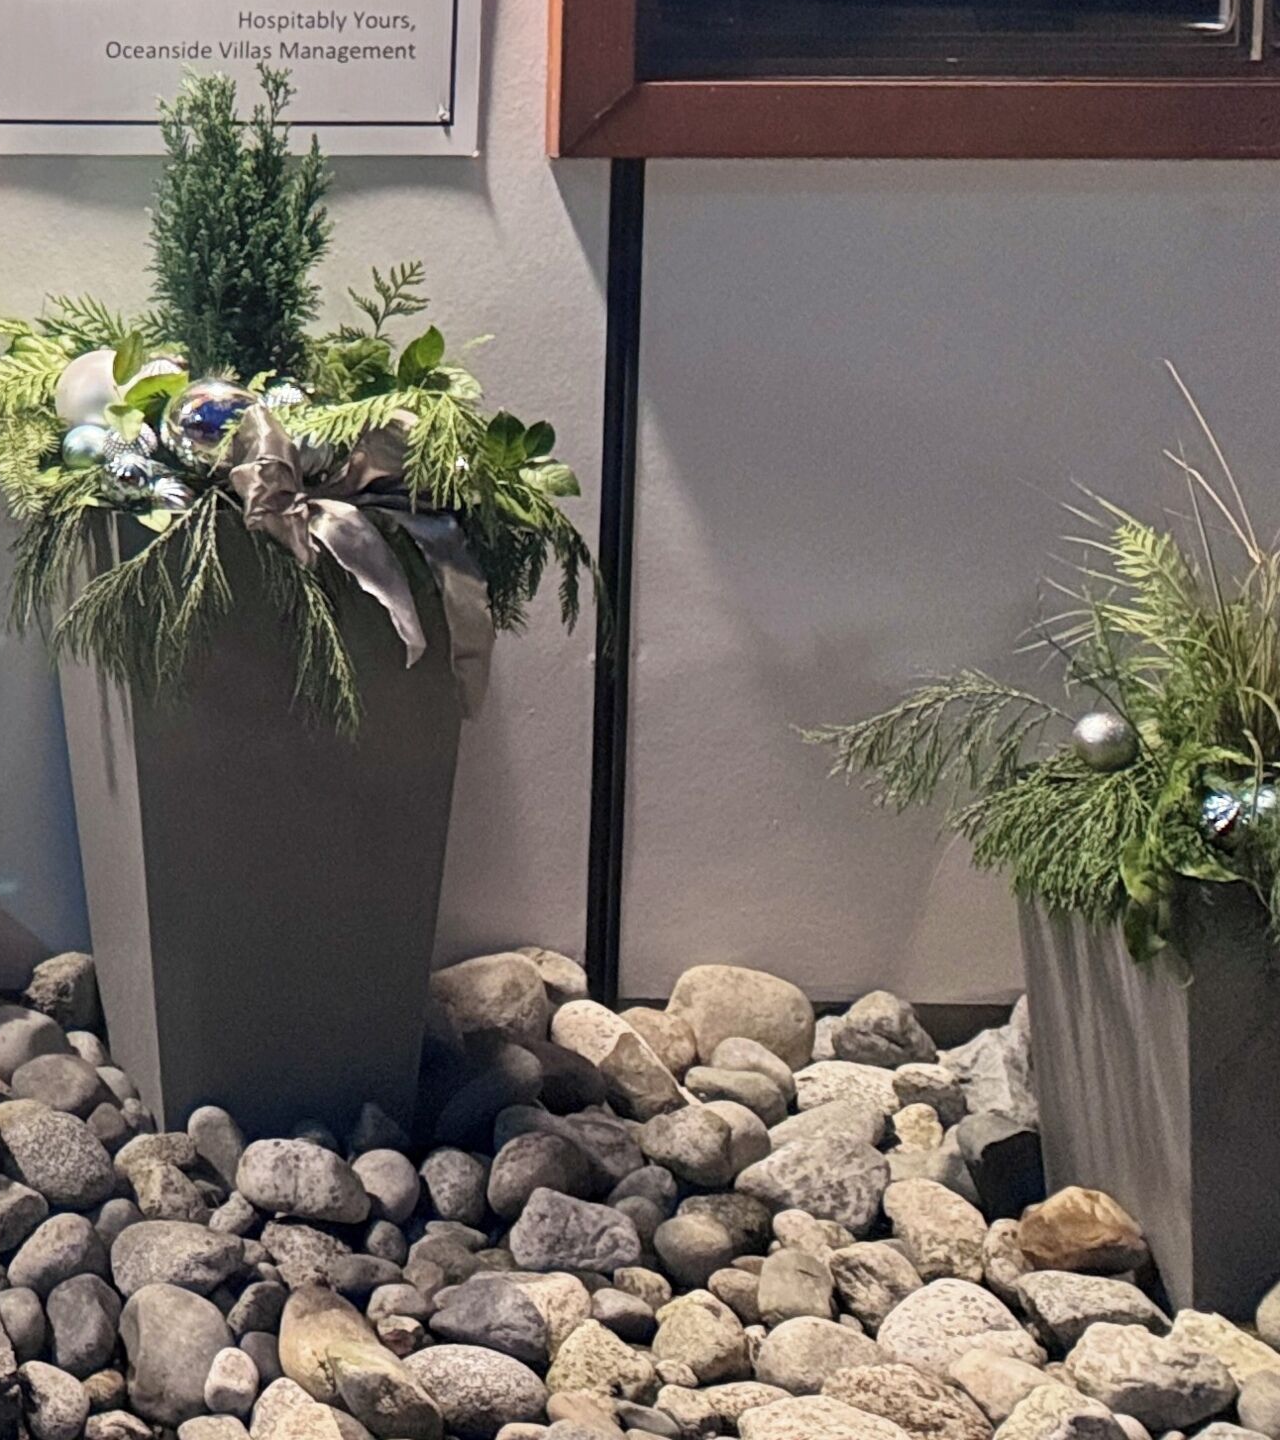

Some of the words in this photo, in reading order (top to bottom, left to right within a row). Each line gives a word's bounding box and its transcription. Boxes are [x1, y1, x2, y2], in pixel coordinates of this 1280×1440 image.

[238, 9, 345, 34] Hospitably
[353, 10, 416, 33] Yours,
[105, 40, 213, 60] Oceanside
[218, 39, 273, 61] Villas
[279, 41, 417, 64] Management
